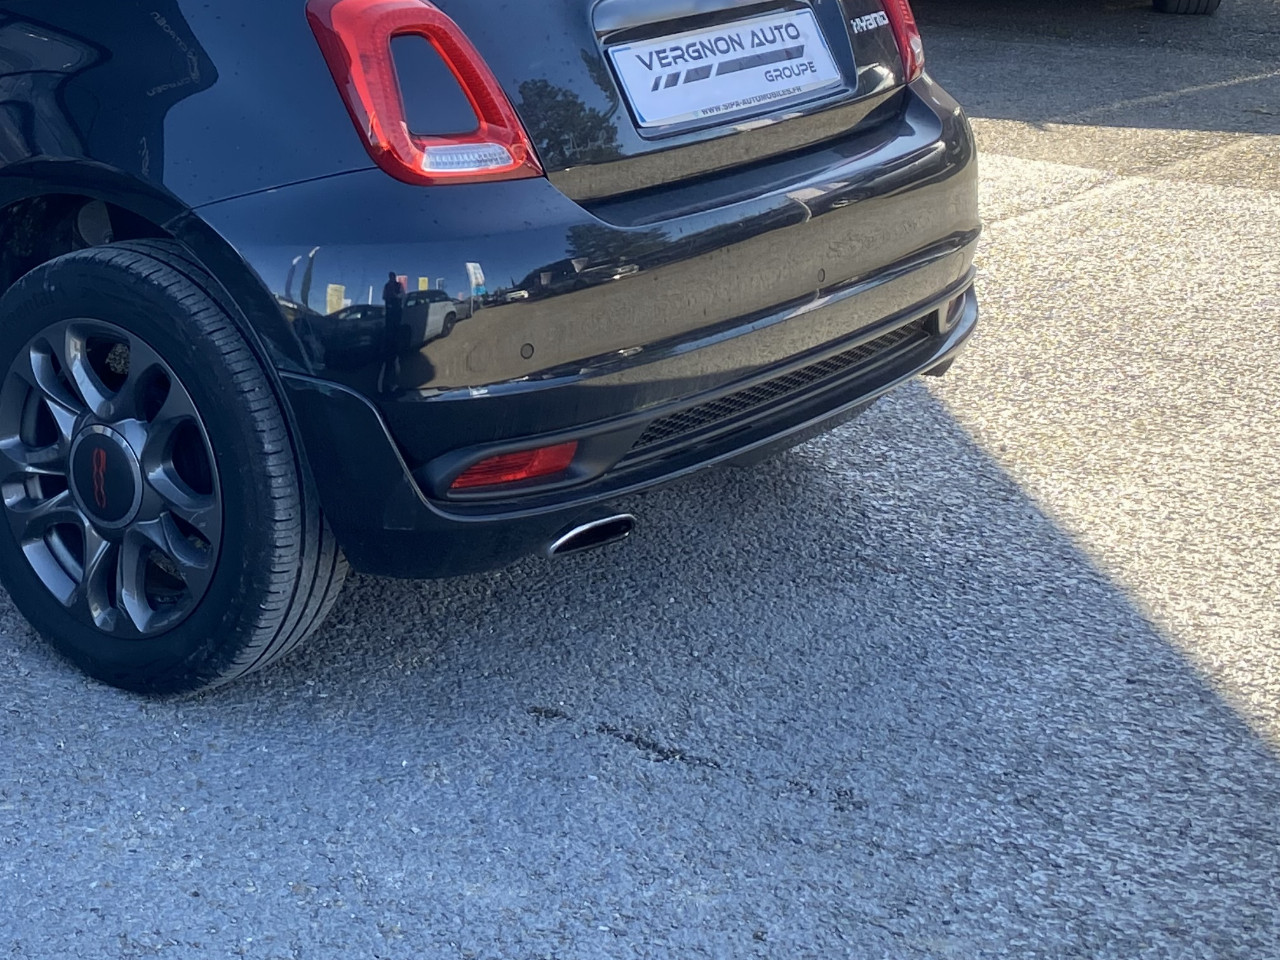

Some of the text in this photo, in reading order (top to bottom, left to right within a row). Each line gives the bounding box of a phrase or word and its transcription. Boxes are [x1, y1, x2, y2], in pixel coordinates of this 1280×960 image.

[635, 22, 801, 71] VERGNON AUTO
[764, 60, 817, 83] GROUPE
